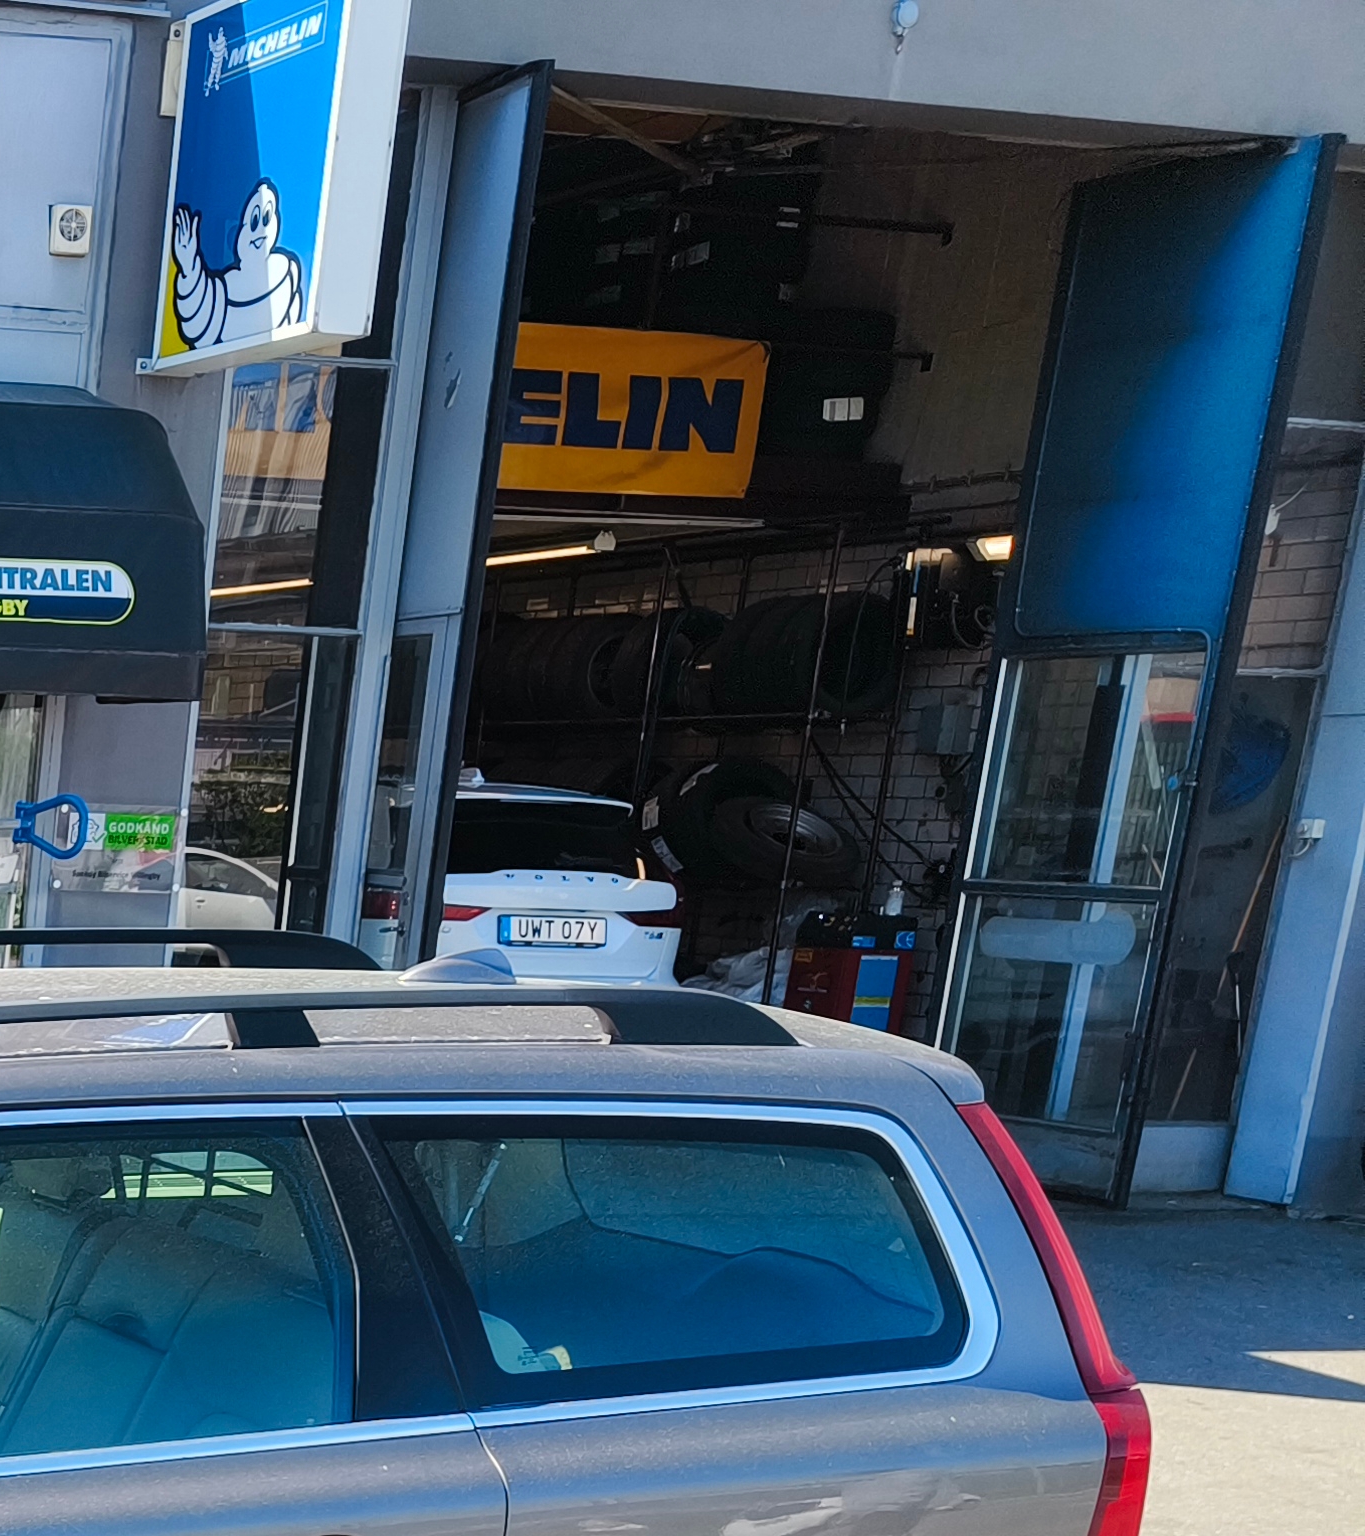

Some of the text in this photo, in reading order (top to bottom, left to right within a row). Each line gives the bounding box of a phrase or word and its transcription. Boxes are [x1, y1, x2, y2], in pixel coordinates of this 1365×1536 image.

[228, 12, 324, 69] MICHELIN
[518, 919, 598, 940] UWT 07Y
